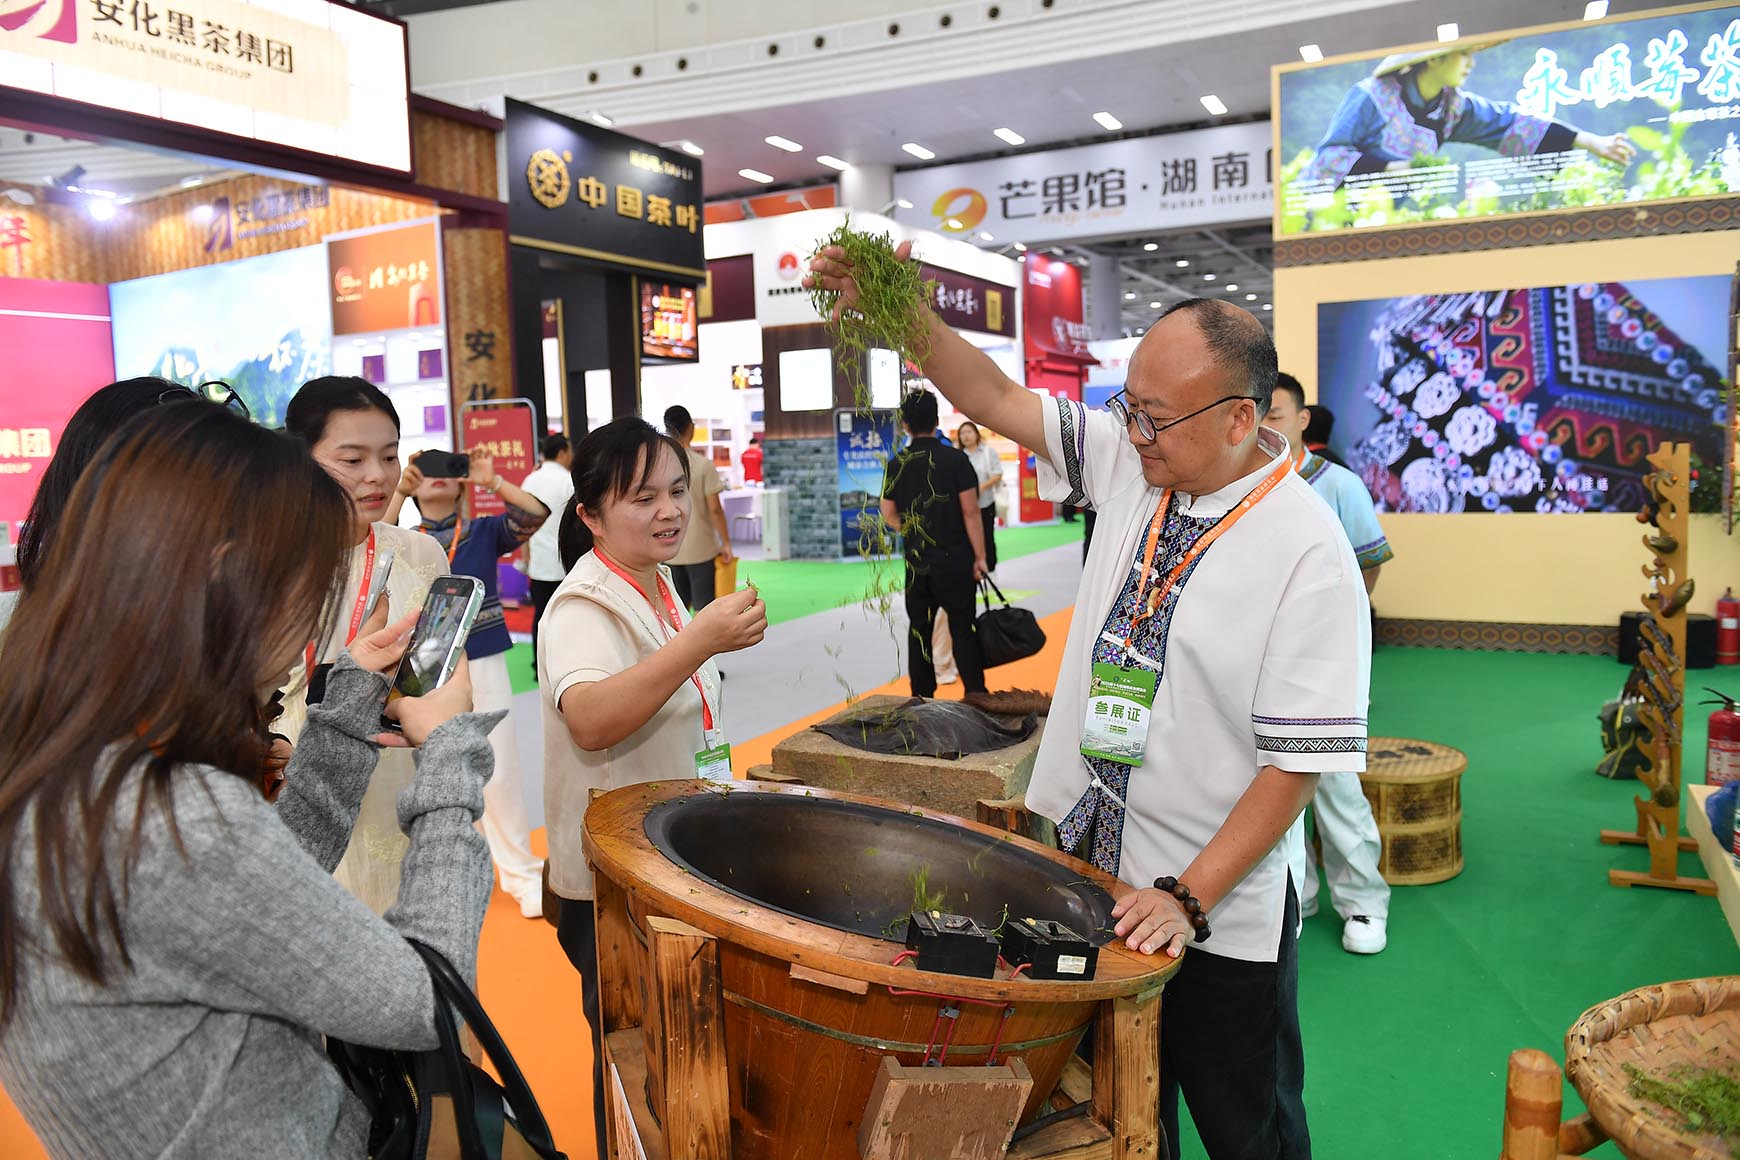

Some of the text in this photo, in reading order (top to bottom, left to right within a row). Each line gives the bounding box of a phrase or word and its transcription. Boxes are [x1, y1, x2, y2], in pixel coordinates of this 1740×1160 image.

[90, 0, 293, 73] 安化黑茶集团
[92, 32, 252, 80] ANHUA HEICHA GROUP
[578, 175, 700, 234] 中国茶叶
[999, 152, 1273, 219] 芒果馆·湖南
